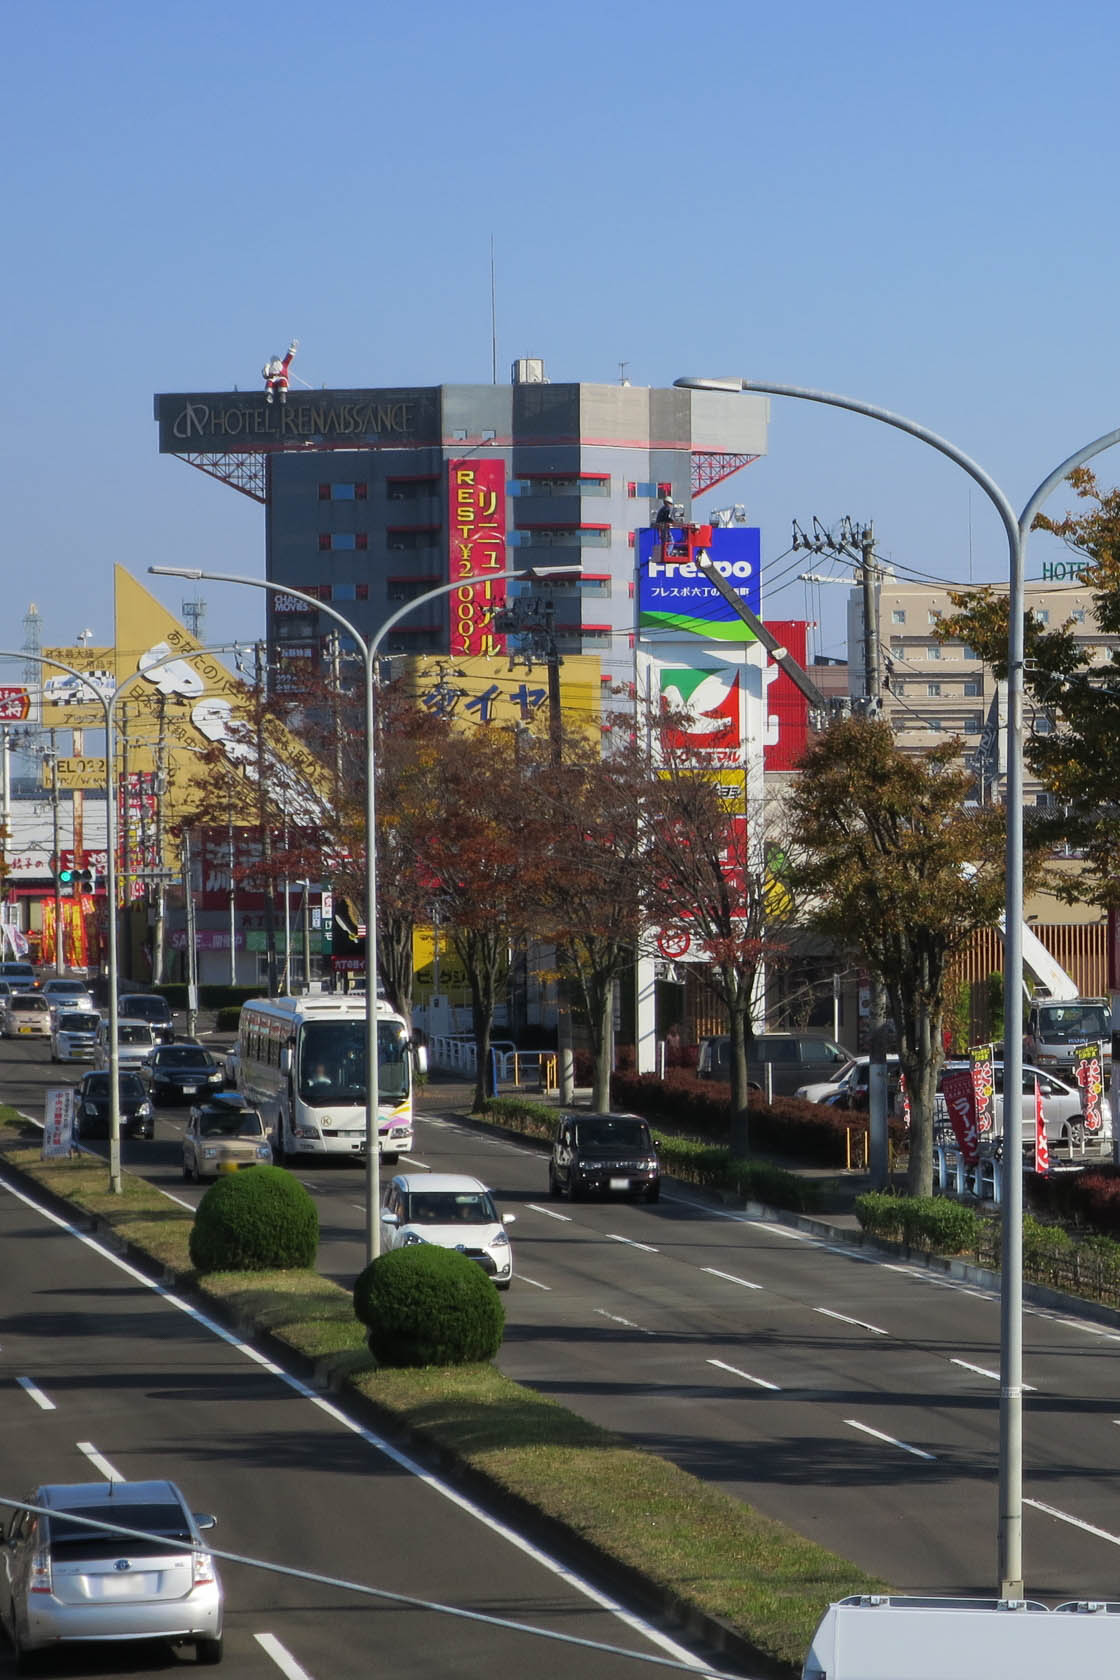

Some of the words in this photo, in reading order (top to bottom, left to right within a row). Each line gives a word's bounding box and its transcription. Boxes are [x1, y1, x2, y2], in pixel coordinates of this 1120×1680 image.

[207, 406, 273, 435] HOTEL
[281, 402, 416, 434] RENAISSANCE
[477, 491, 502, 656] リニューアル
